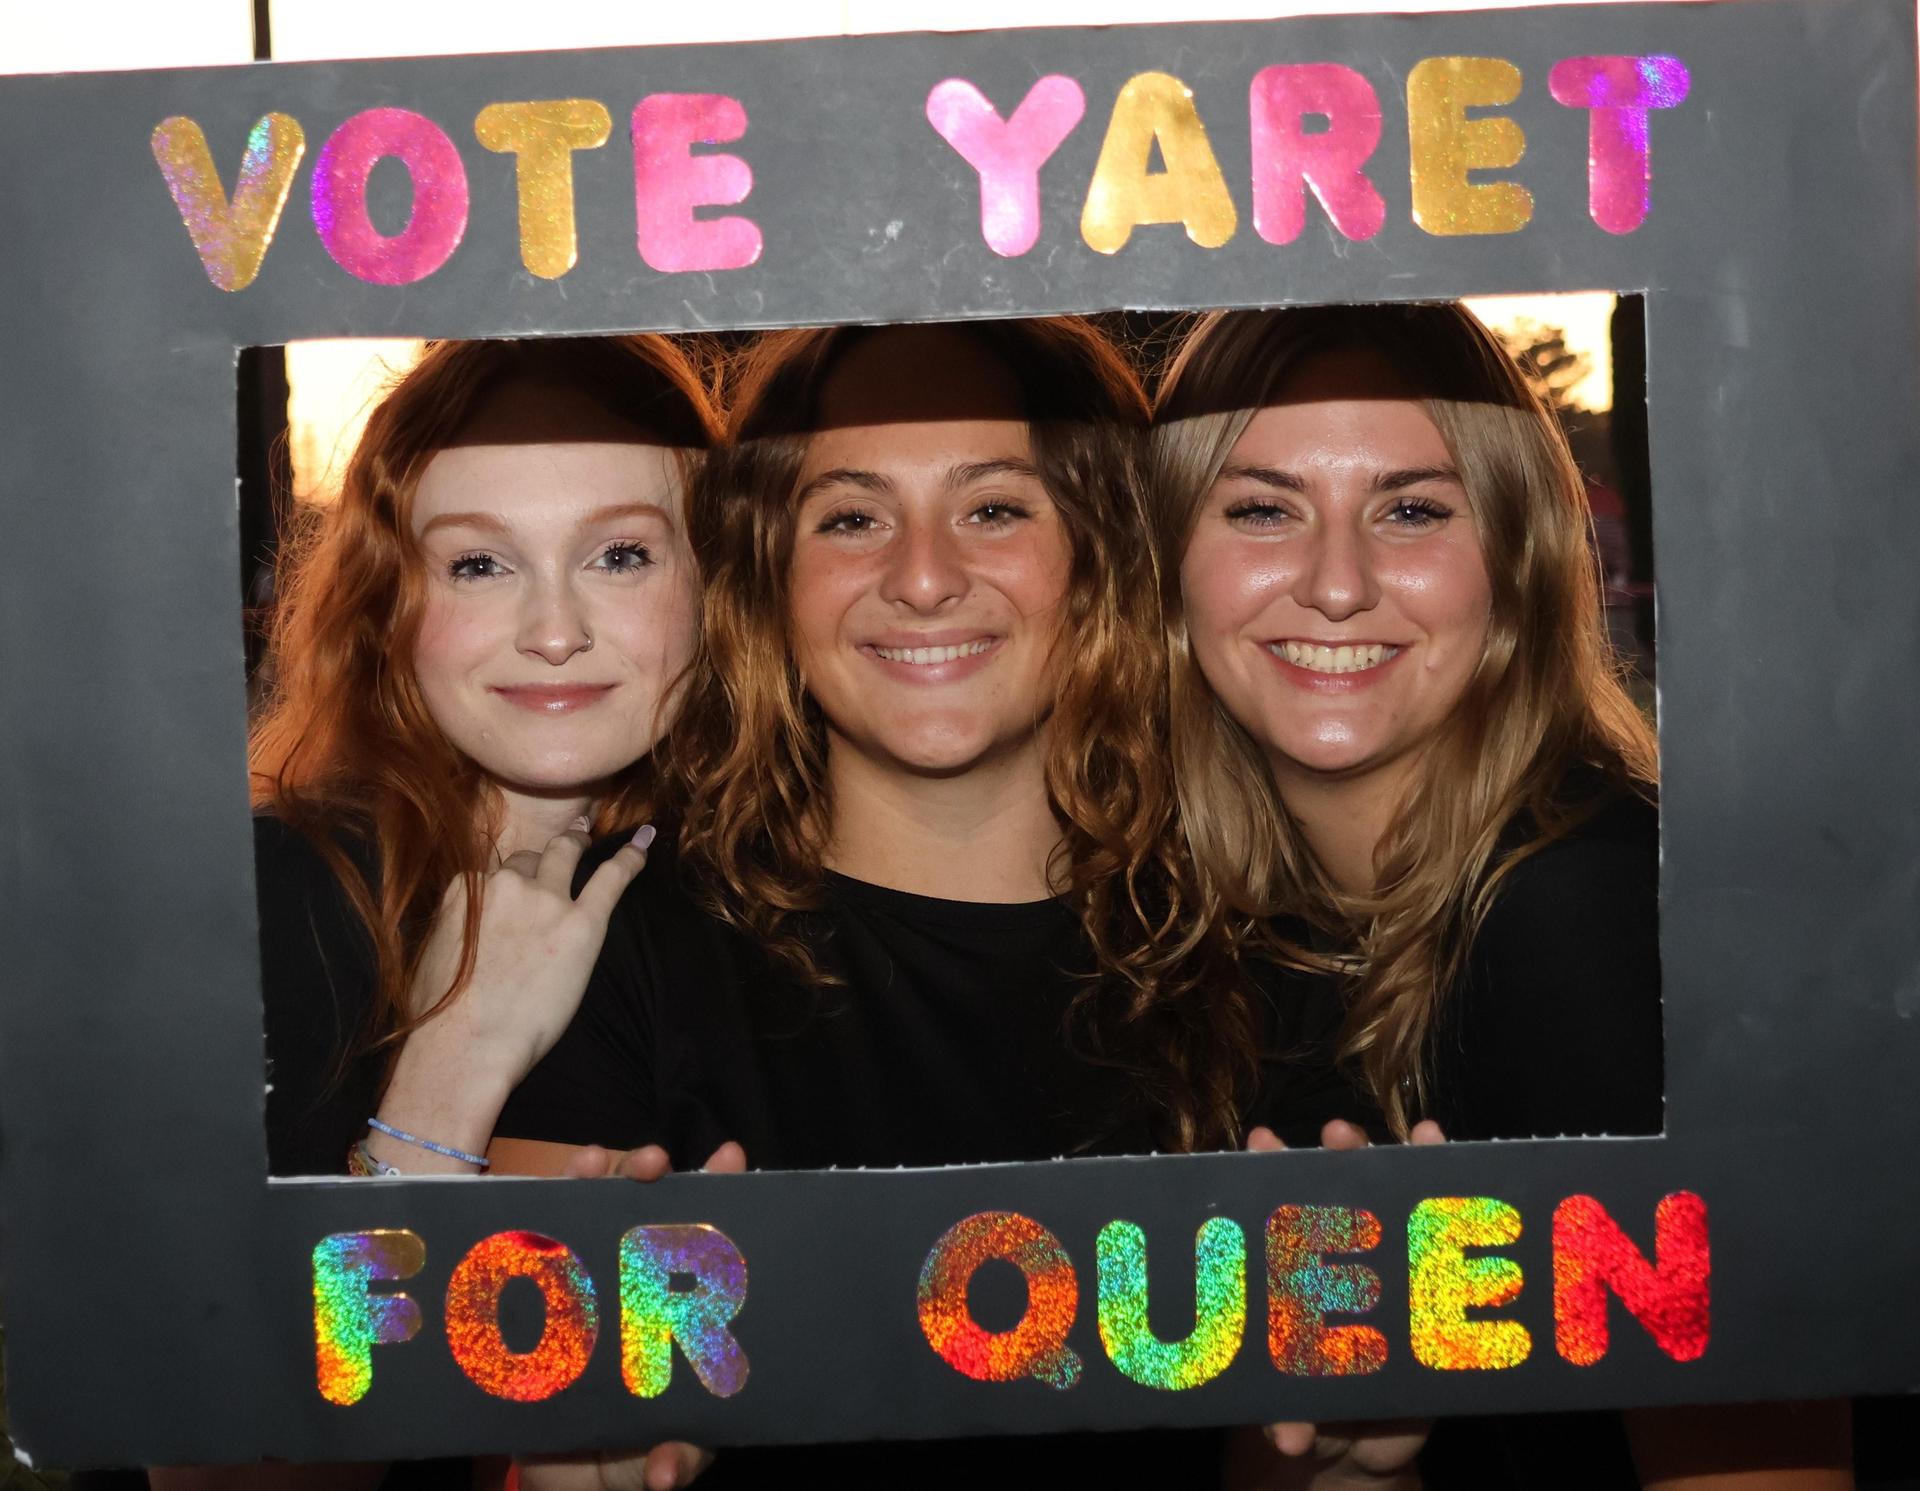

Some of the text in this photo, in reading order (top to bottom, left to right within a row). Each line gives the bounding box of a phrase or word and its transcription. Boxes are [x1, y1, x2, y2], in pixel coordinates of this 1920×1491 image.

[150, 54, 1692, 292] VOTE YARET
[312, 1190, 1711, 1406] FOR QUEEN
